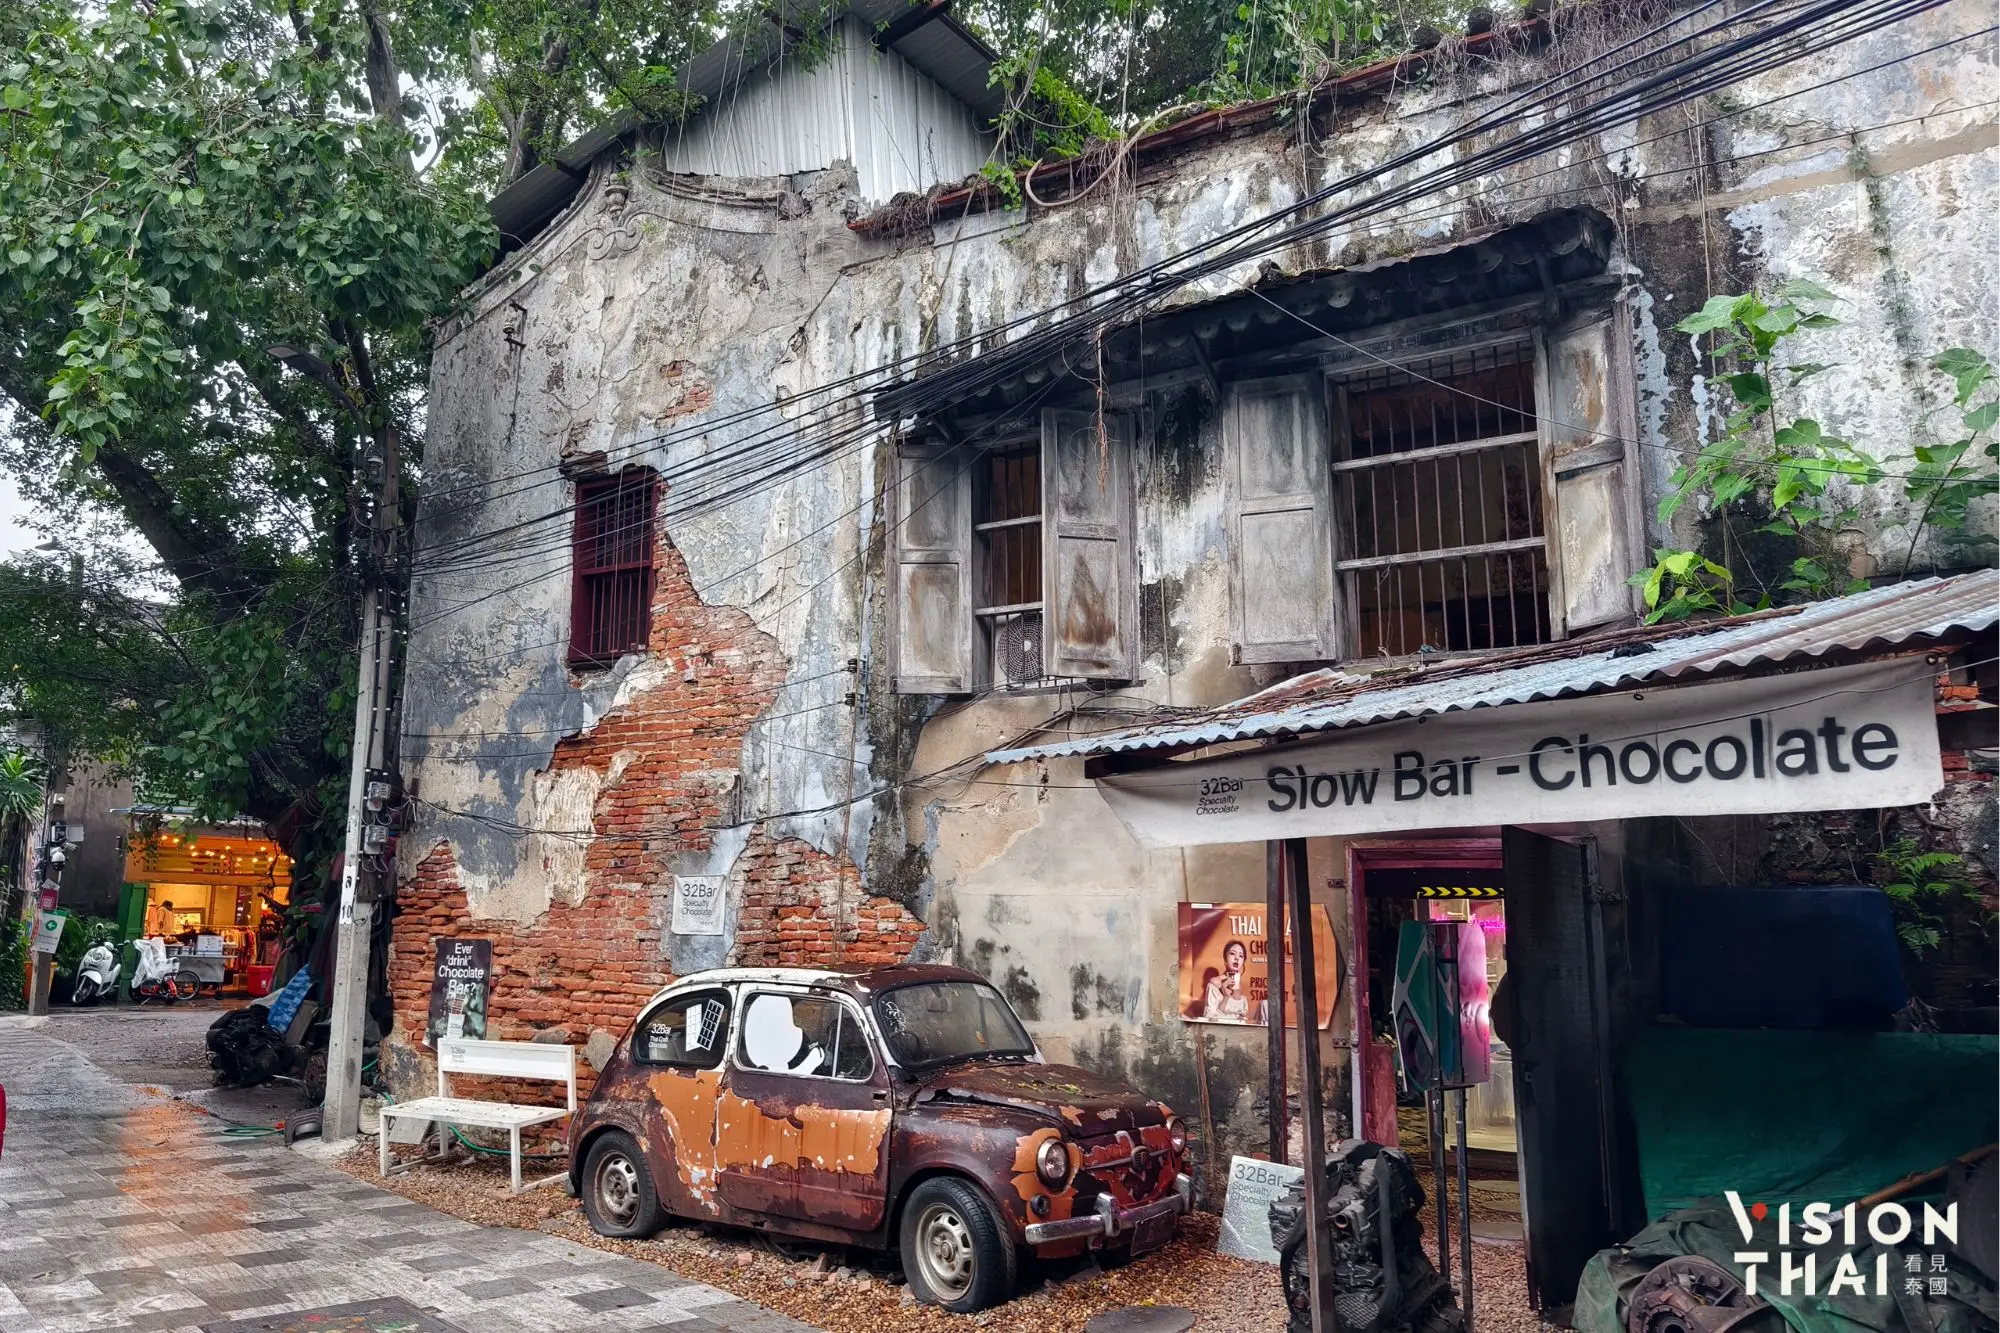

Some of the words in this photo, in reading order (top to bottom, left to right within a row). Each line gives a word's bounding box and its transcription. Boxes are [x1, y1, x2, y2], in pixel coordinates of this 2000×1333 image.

[1267, 764, 1380, 813] Slow
[1393, 748, 1481, 803] Bar
[1528, 716, 1900, 792] Chocolate
[1200, 776, 1244, 796] 32Bar
[1198, 795, 1236, 807] Specialty
[1196, 805, 1239, 816] Chocolate
[683, 883, 718, 897] 32Bar
[681, 907, 713, 916] Chocolate
[1228, 914, 1263, 937] THAI
[454, 942, 474, 954] Ever
[438, 965, 485, 979] Chocolate
[448, 979, 477, 996] Bar?
[651, 1023, 672, 1035] 32Bar
[1235, 1163, 1284, 1187] 32Bar
[1230, 1190, 1270, 1207] Chocolat
